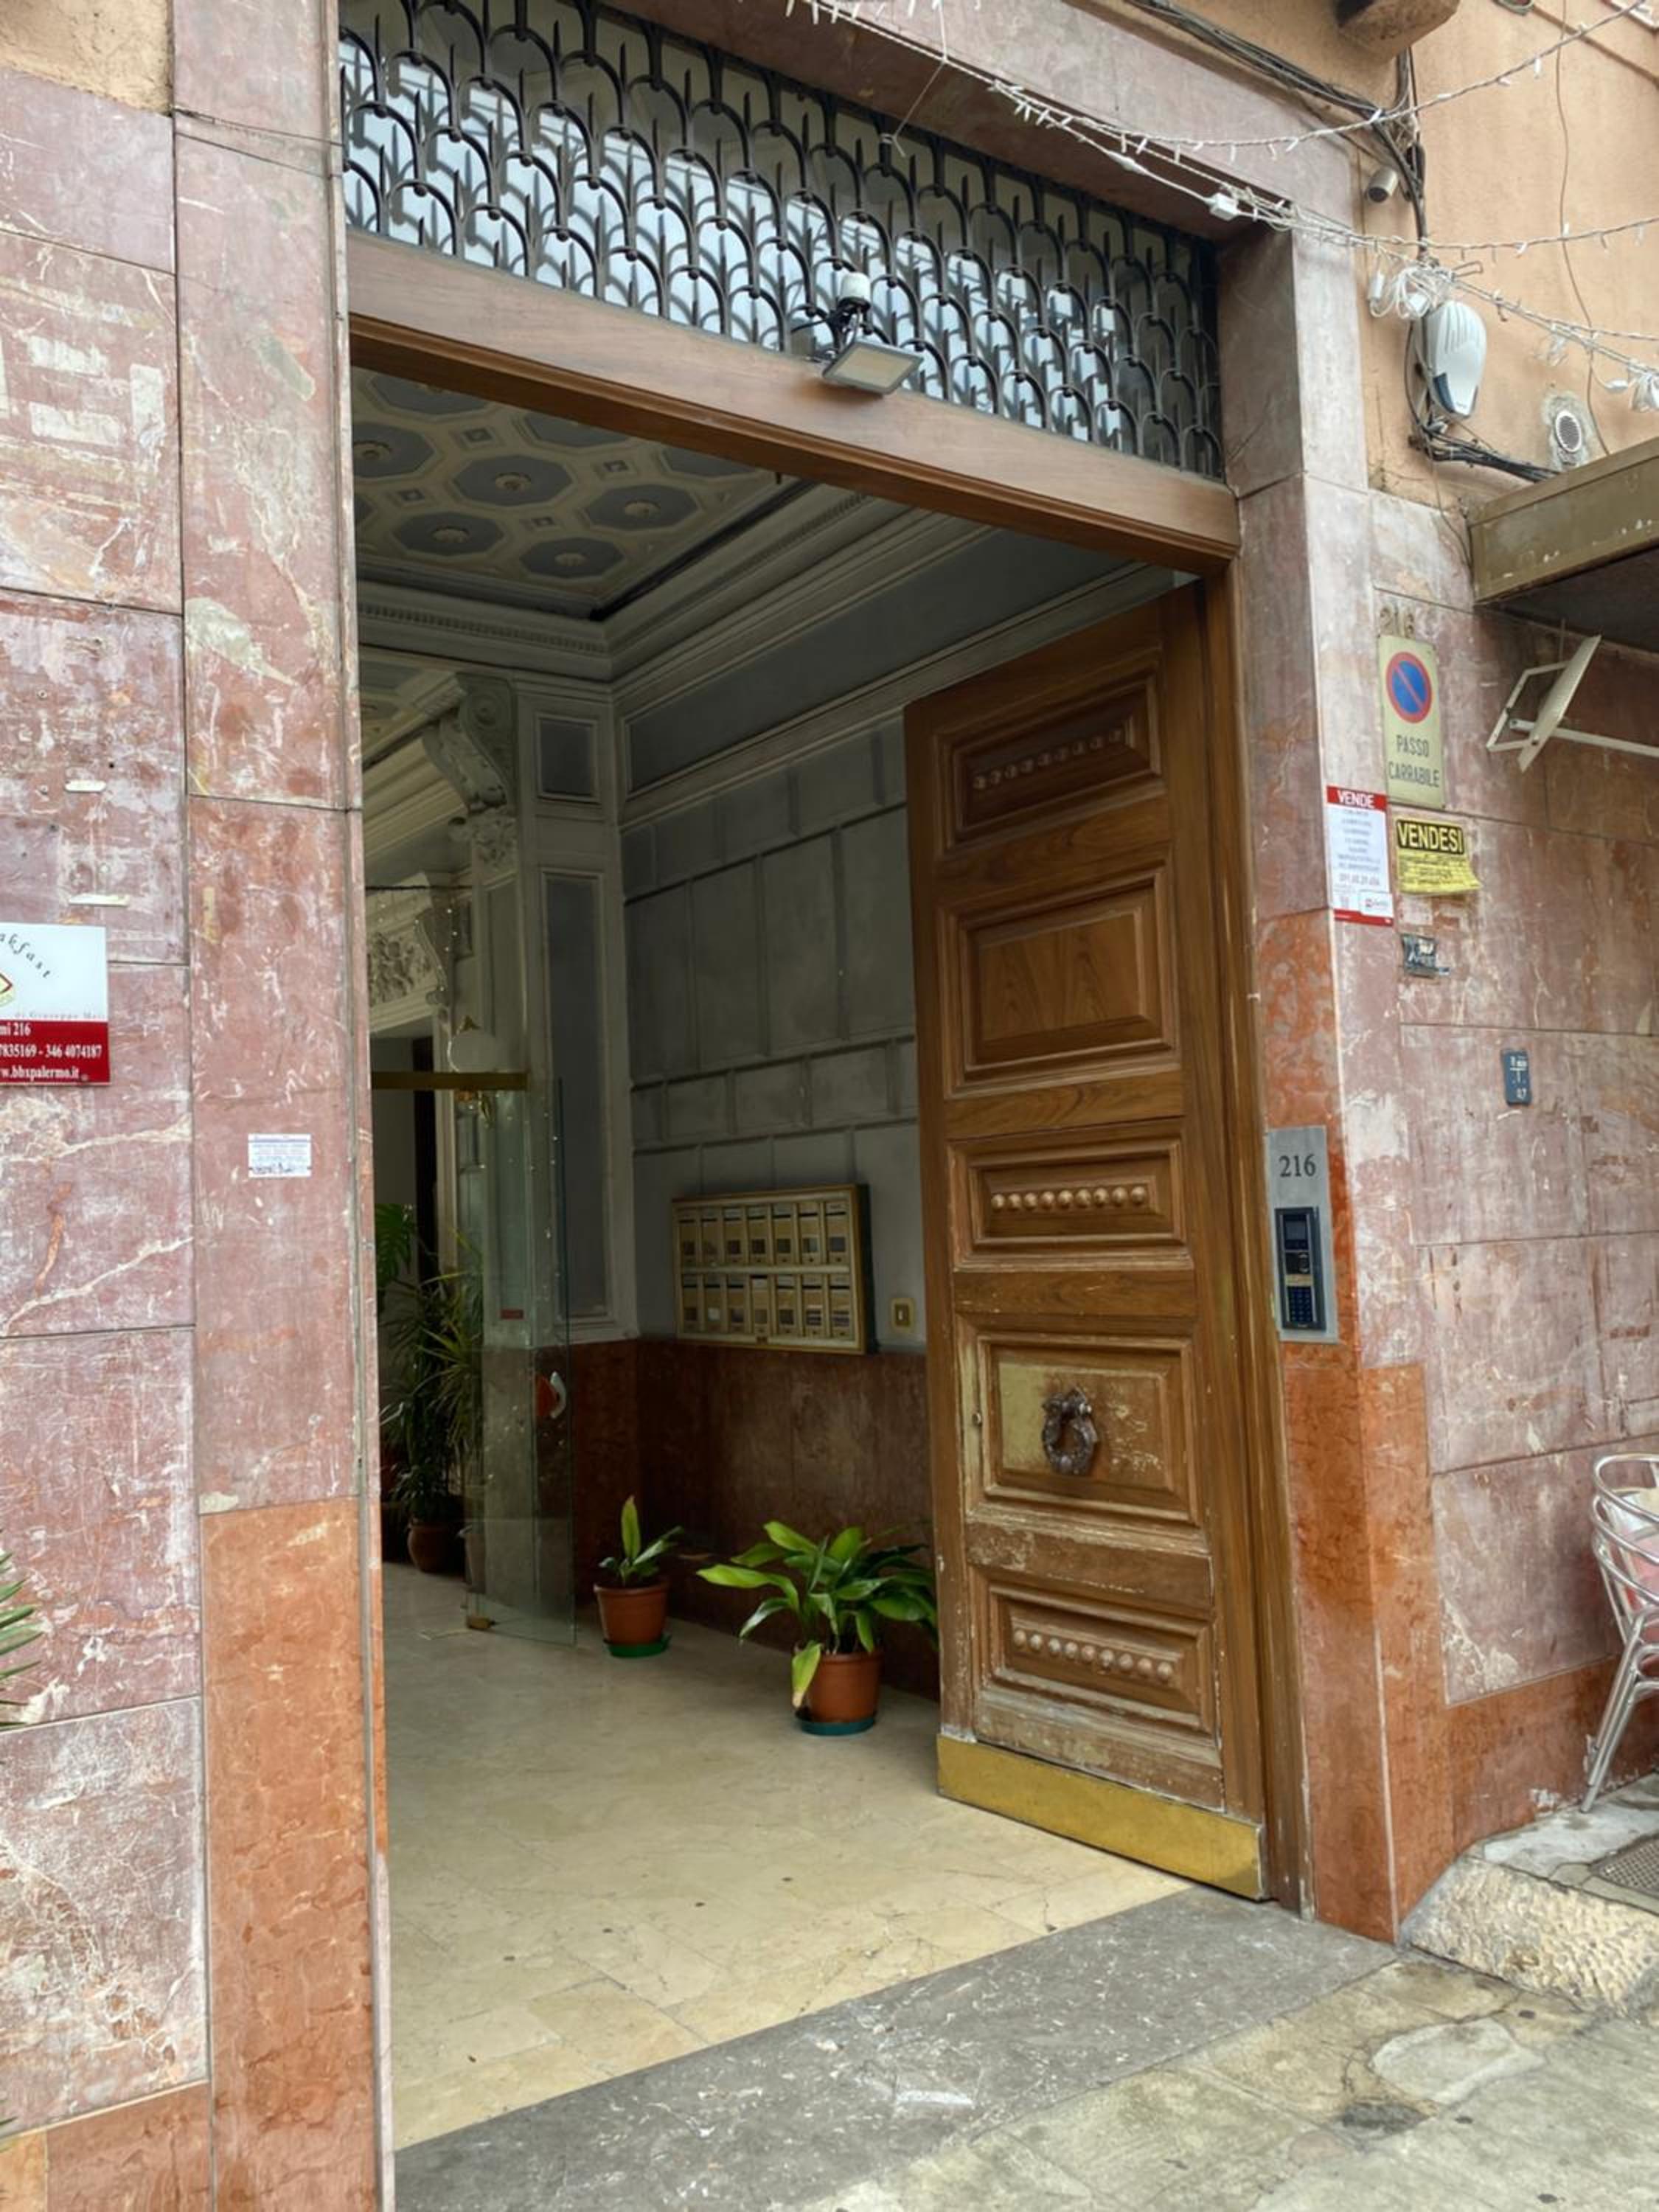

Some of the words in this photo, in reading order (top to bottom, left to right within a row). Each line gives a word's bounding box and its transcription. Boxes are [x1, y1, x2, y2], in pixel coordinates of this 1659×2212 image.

[1397, 734, 1429, 757] PASSO
[1388, 761, 1440, 788] CARRABILE
[1338, 790, 1374, 810] VENDE
[1397, 822, 1463, 852] VENDESI
[13, 1022, 31, 1037] 216
[45, 1043, 63, 1059] 346
[1279, 1154, 1317, 1178] 216
